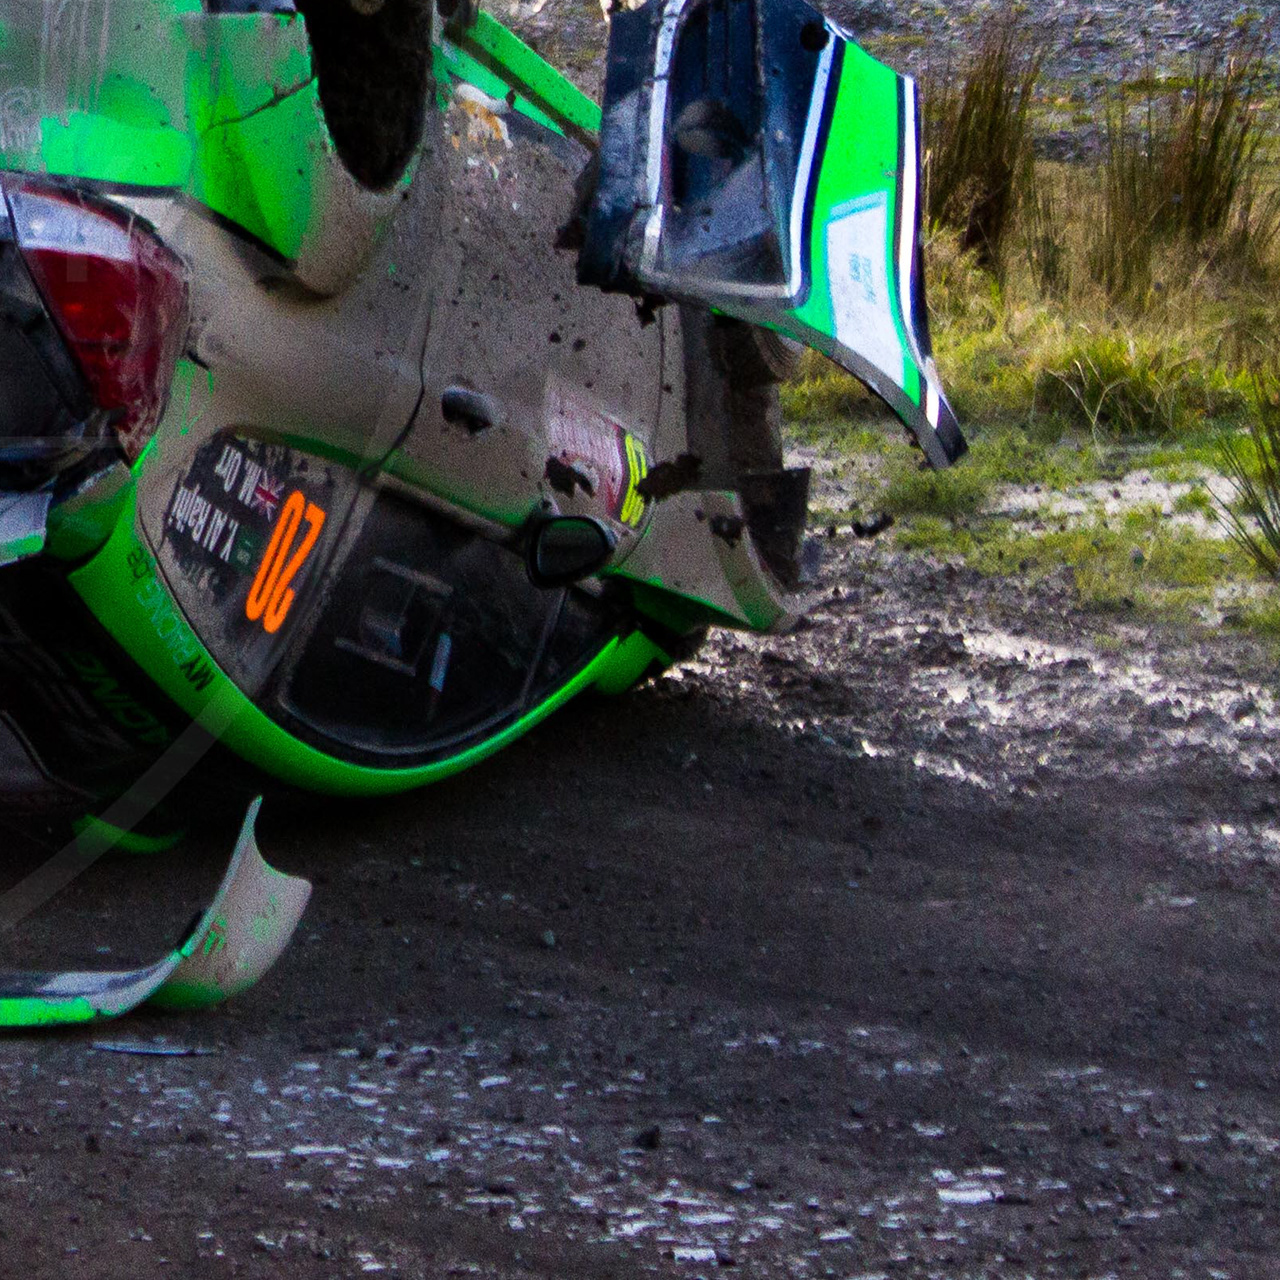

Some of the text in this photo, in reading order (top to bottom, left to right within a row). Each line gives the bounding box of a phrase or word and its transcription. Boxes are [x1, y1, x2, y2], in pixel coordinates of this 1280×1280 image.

[215, 443, 261, 506] M. Orr
[165, 483, 212, 539] Rajhi
[246, 490, 327, 634] 20
